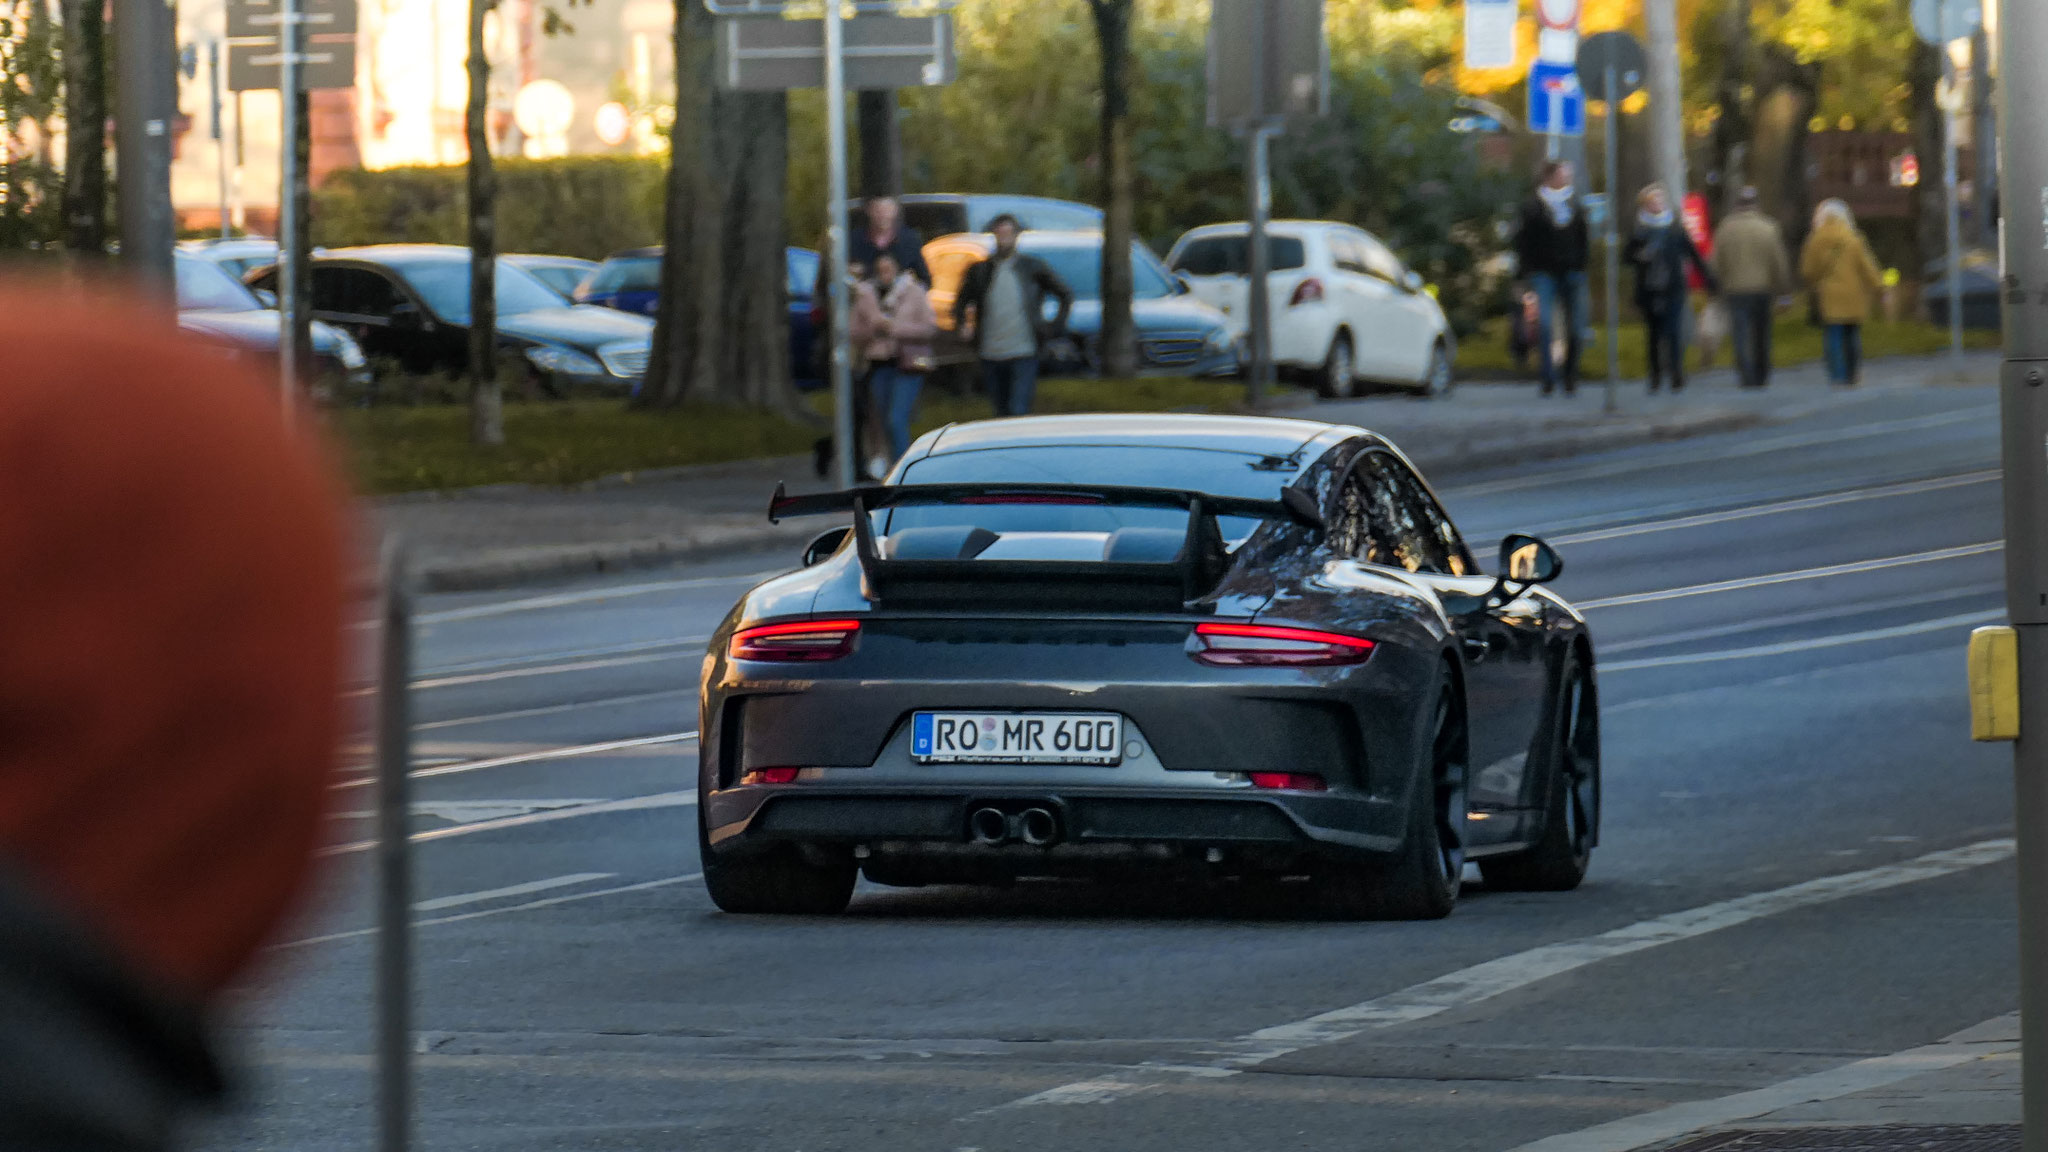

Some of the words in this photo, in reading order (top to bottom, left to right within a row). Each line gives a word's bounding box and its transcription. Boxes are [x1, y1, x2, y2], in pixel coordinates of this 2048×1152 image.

[936, 719, 978, 750] RO
[1002, 719, 1044, 751] MR
[1053, 720, 1114, 751] 600
